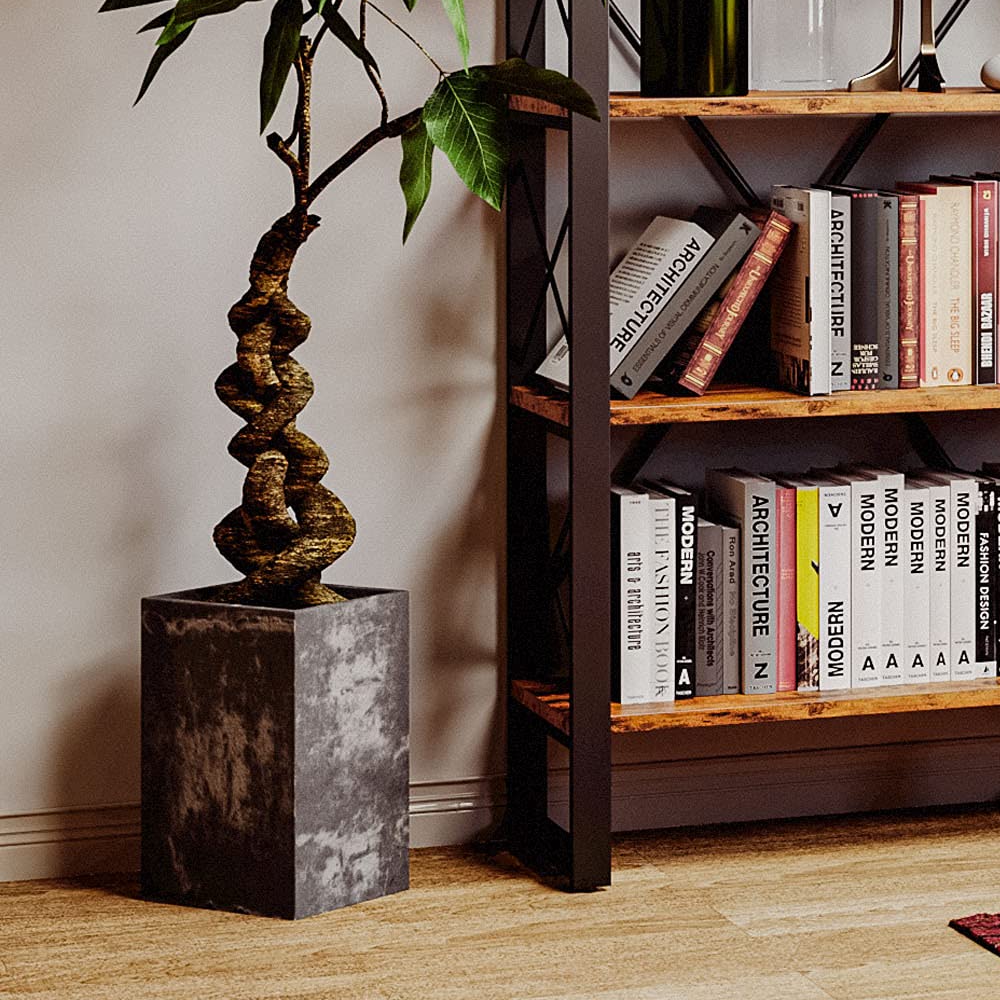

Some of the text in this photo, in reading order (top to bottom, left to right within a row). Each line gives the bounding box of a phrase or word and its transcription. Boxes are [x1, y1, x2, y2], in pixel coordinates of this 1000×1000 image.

[610, 237, 700, 352] ARCHITECTURE
[831, 209, 844, 337] ARCHITECTURE
[680, 506, 695, 584] MODERN
[828, 503, 843, 517] A
[861, 494, 874, 571] MODERN
[885, 489, 898, 566] MODERN
[911, 502, 924, 574] MODERN
[935, 500, 946, 571] MODERN
[957, 493, 969, 567] MODERN
[627, 551, 640, 571] arts
[655, 550, 669, 635] FASHION
[752, 496, 769, 637] ARCHITECTURE
[979, 532, 989, 630] FASHION DESIGN
[627, 588, 644, 650] architecture
[828, 602, 844, 677] MODERN
[655, 642, 669, 697] BOOK
[679, 669, 690, 684] A
[754, 663, 768, 678] N
[862, 656, 875, 671] A
[886, 654, 898, 668] A
[912, 654, 924, 668] A
[937, 652, 946, 666] A
[958, 651, 969, 664] A
